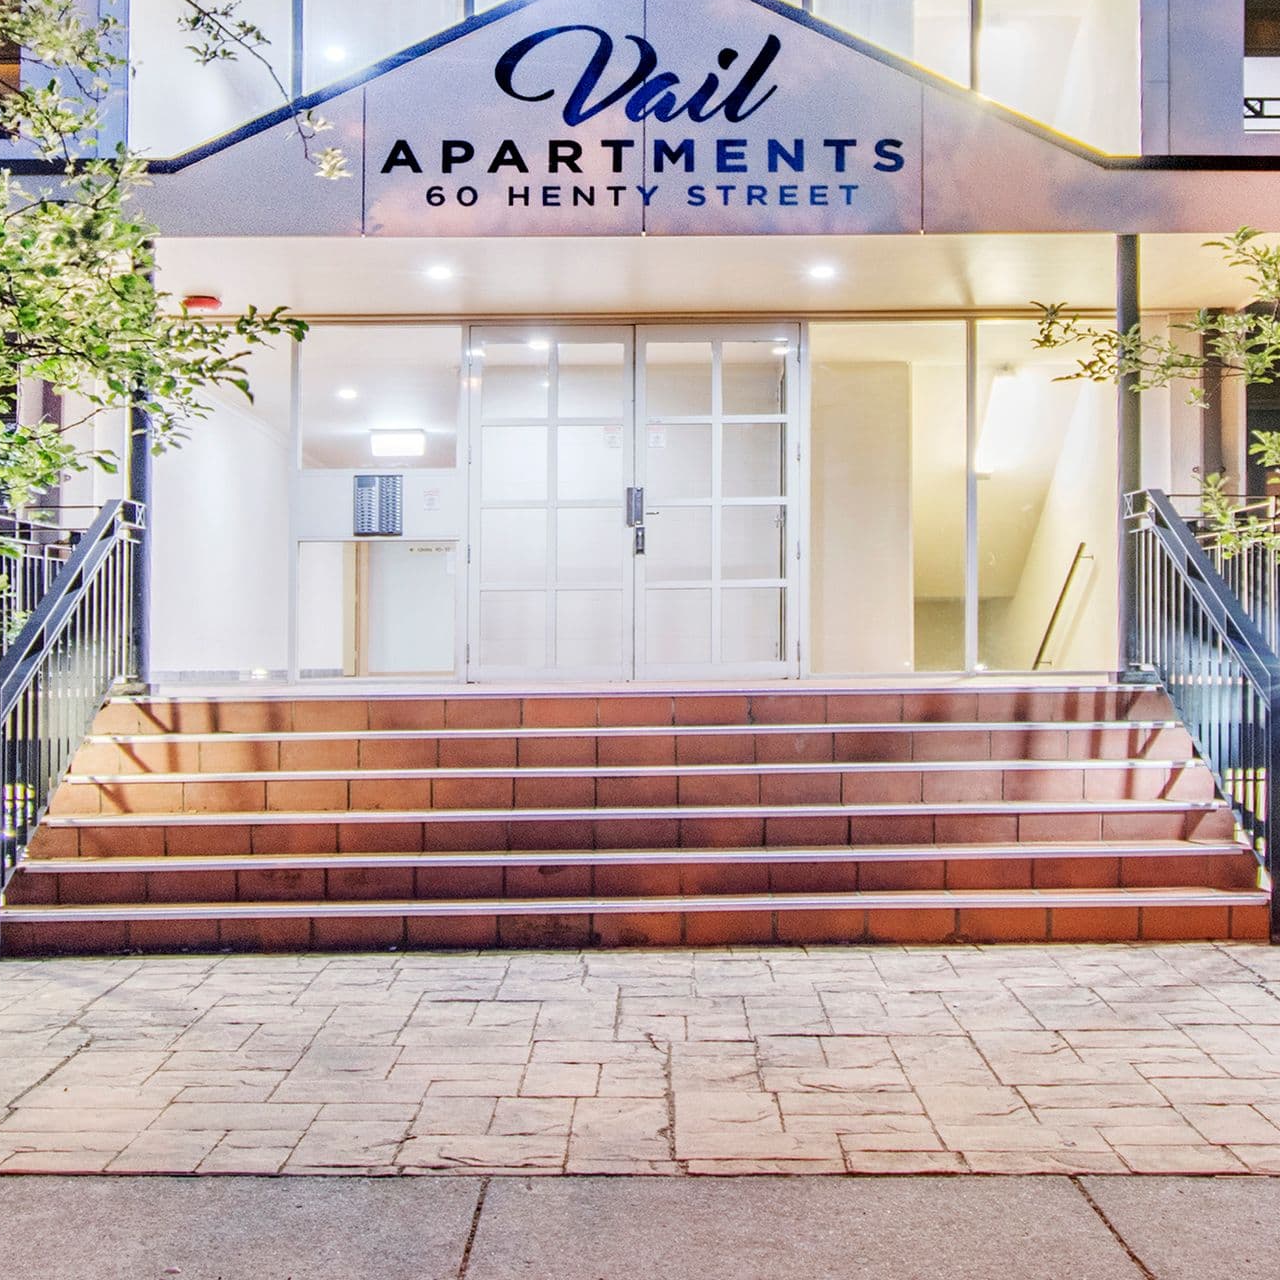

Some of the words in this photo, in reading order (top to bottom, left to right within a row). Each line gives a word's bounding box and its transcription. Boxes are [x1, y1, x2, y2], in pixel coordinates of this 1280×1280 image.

[494, 24, 781, 127] Vail
[380, 139, 906, 174] APARTMENTS
[425, 185, 479, 207] 60
[508, 185, 658, 207] HENTY
[687, 184, 859, 207] STREET
